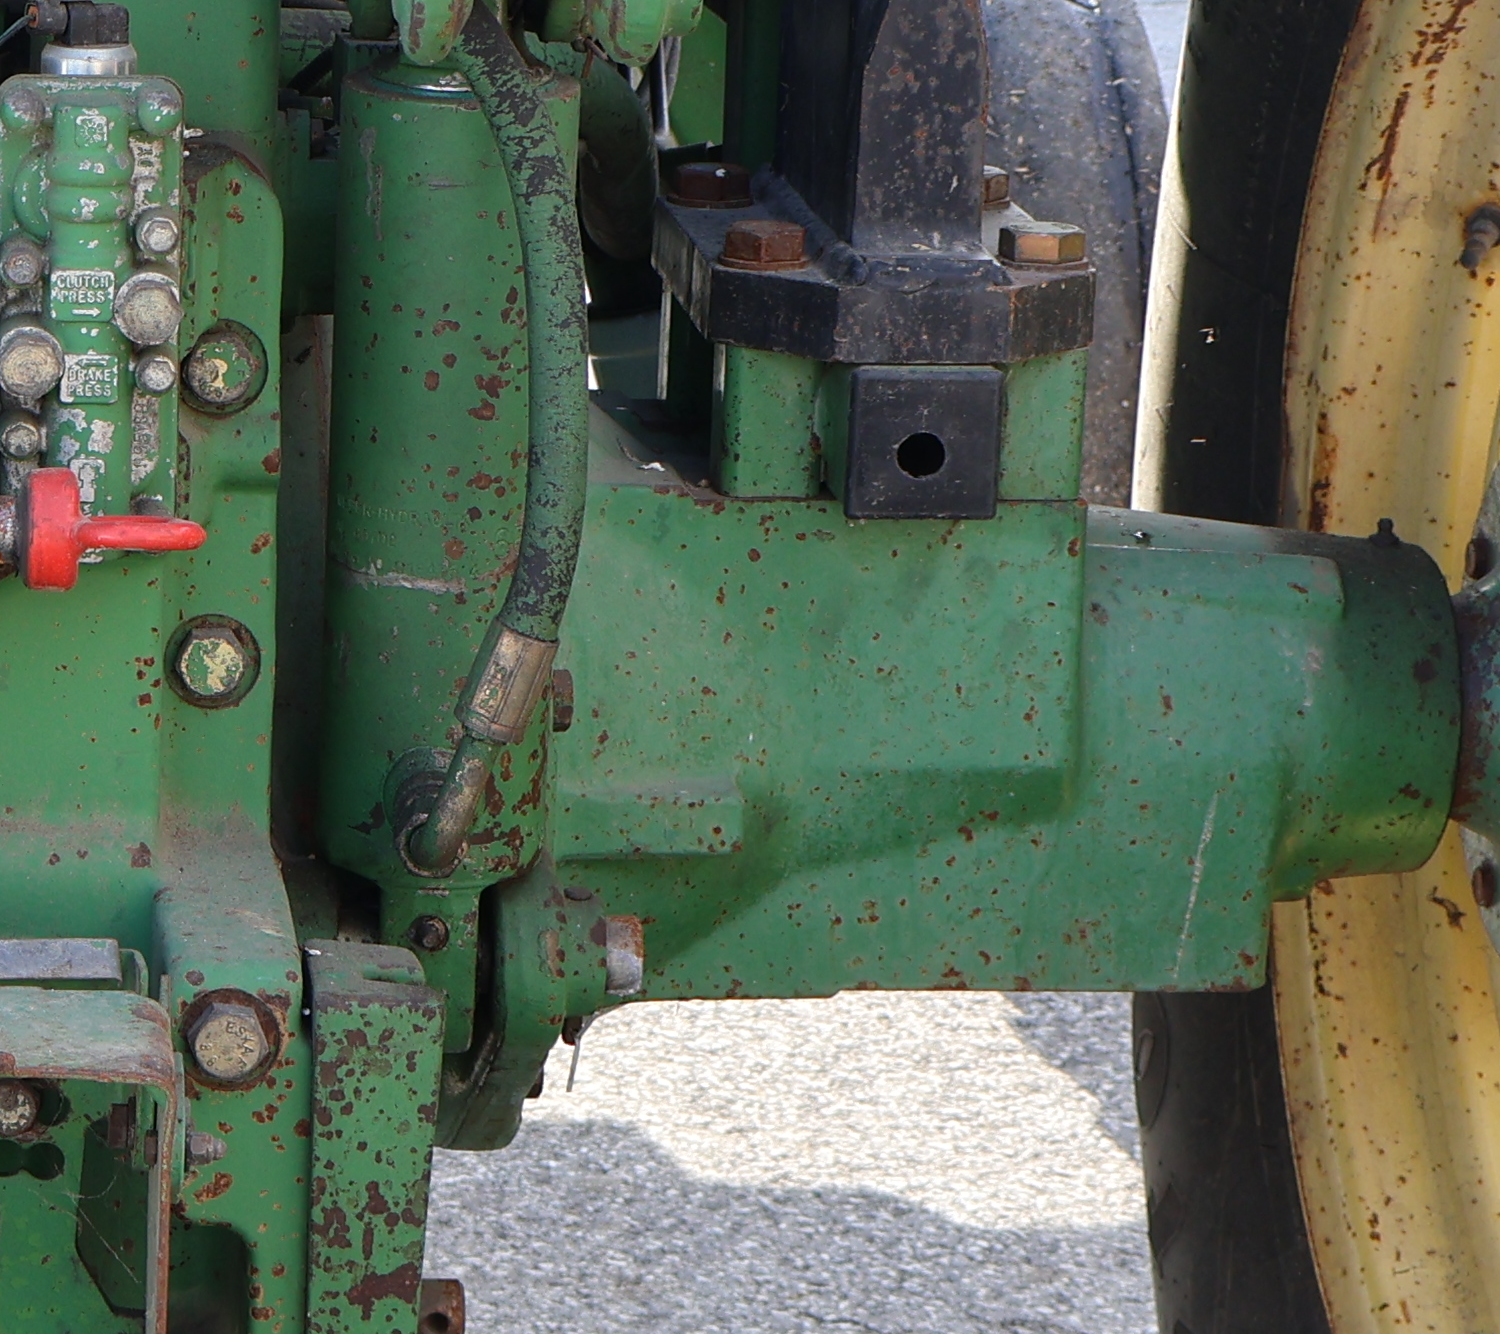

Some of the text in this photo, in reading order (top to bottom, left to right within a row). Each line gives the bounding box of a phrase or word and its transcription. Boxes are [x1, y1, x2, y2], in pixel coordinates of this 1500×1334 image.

[56, 275, 110, 288] CLUTCH
[59, 290, 106, 303] PRESS
[67, 368, 113, 382] BRAKE
[67, 385, 112, 397] PRESS
